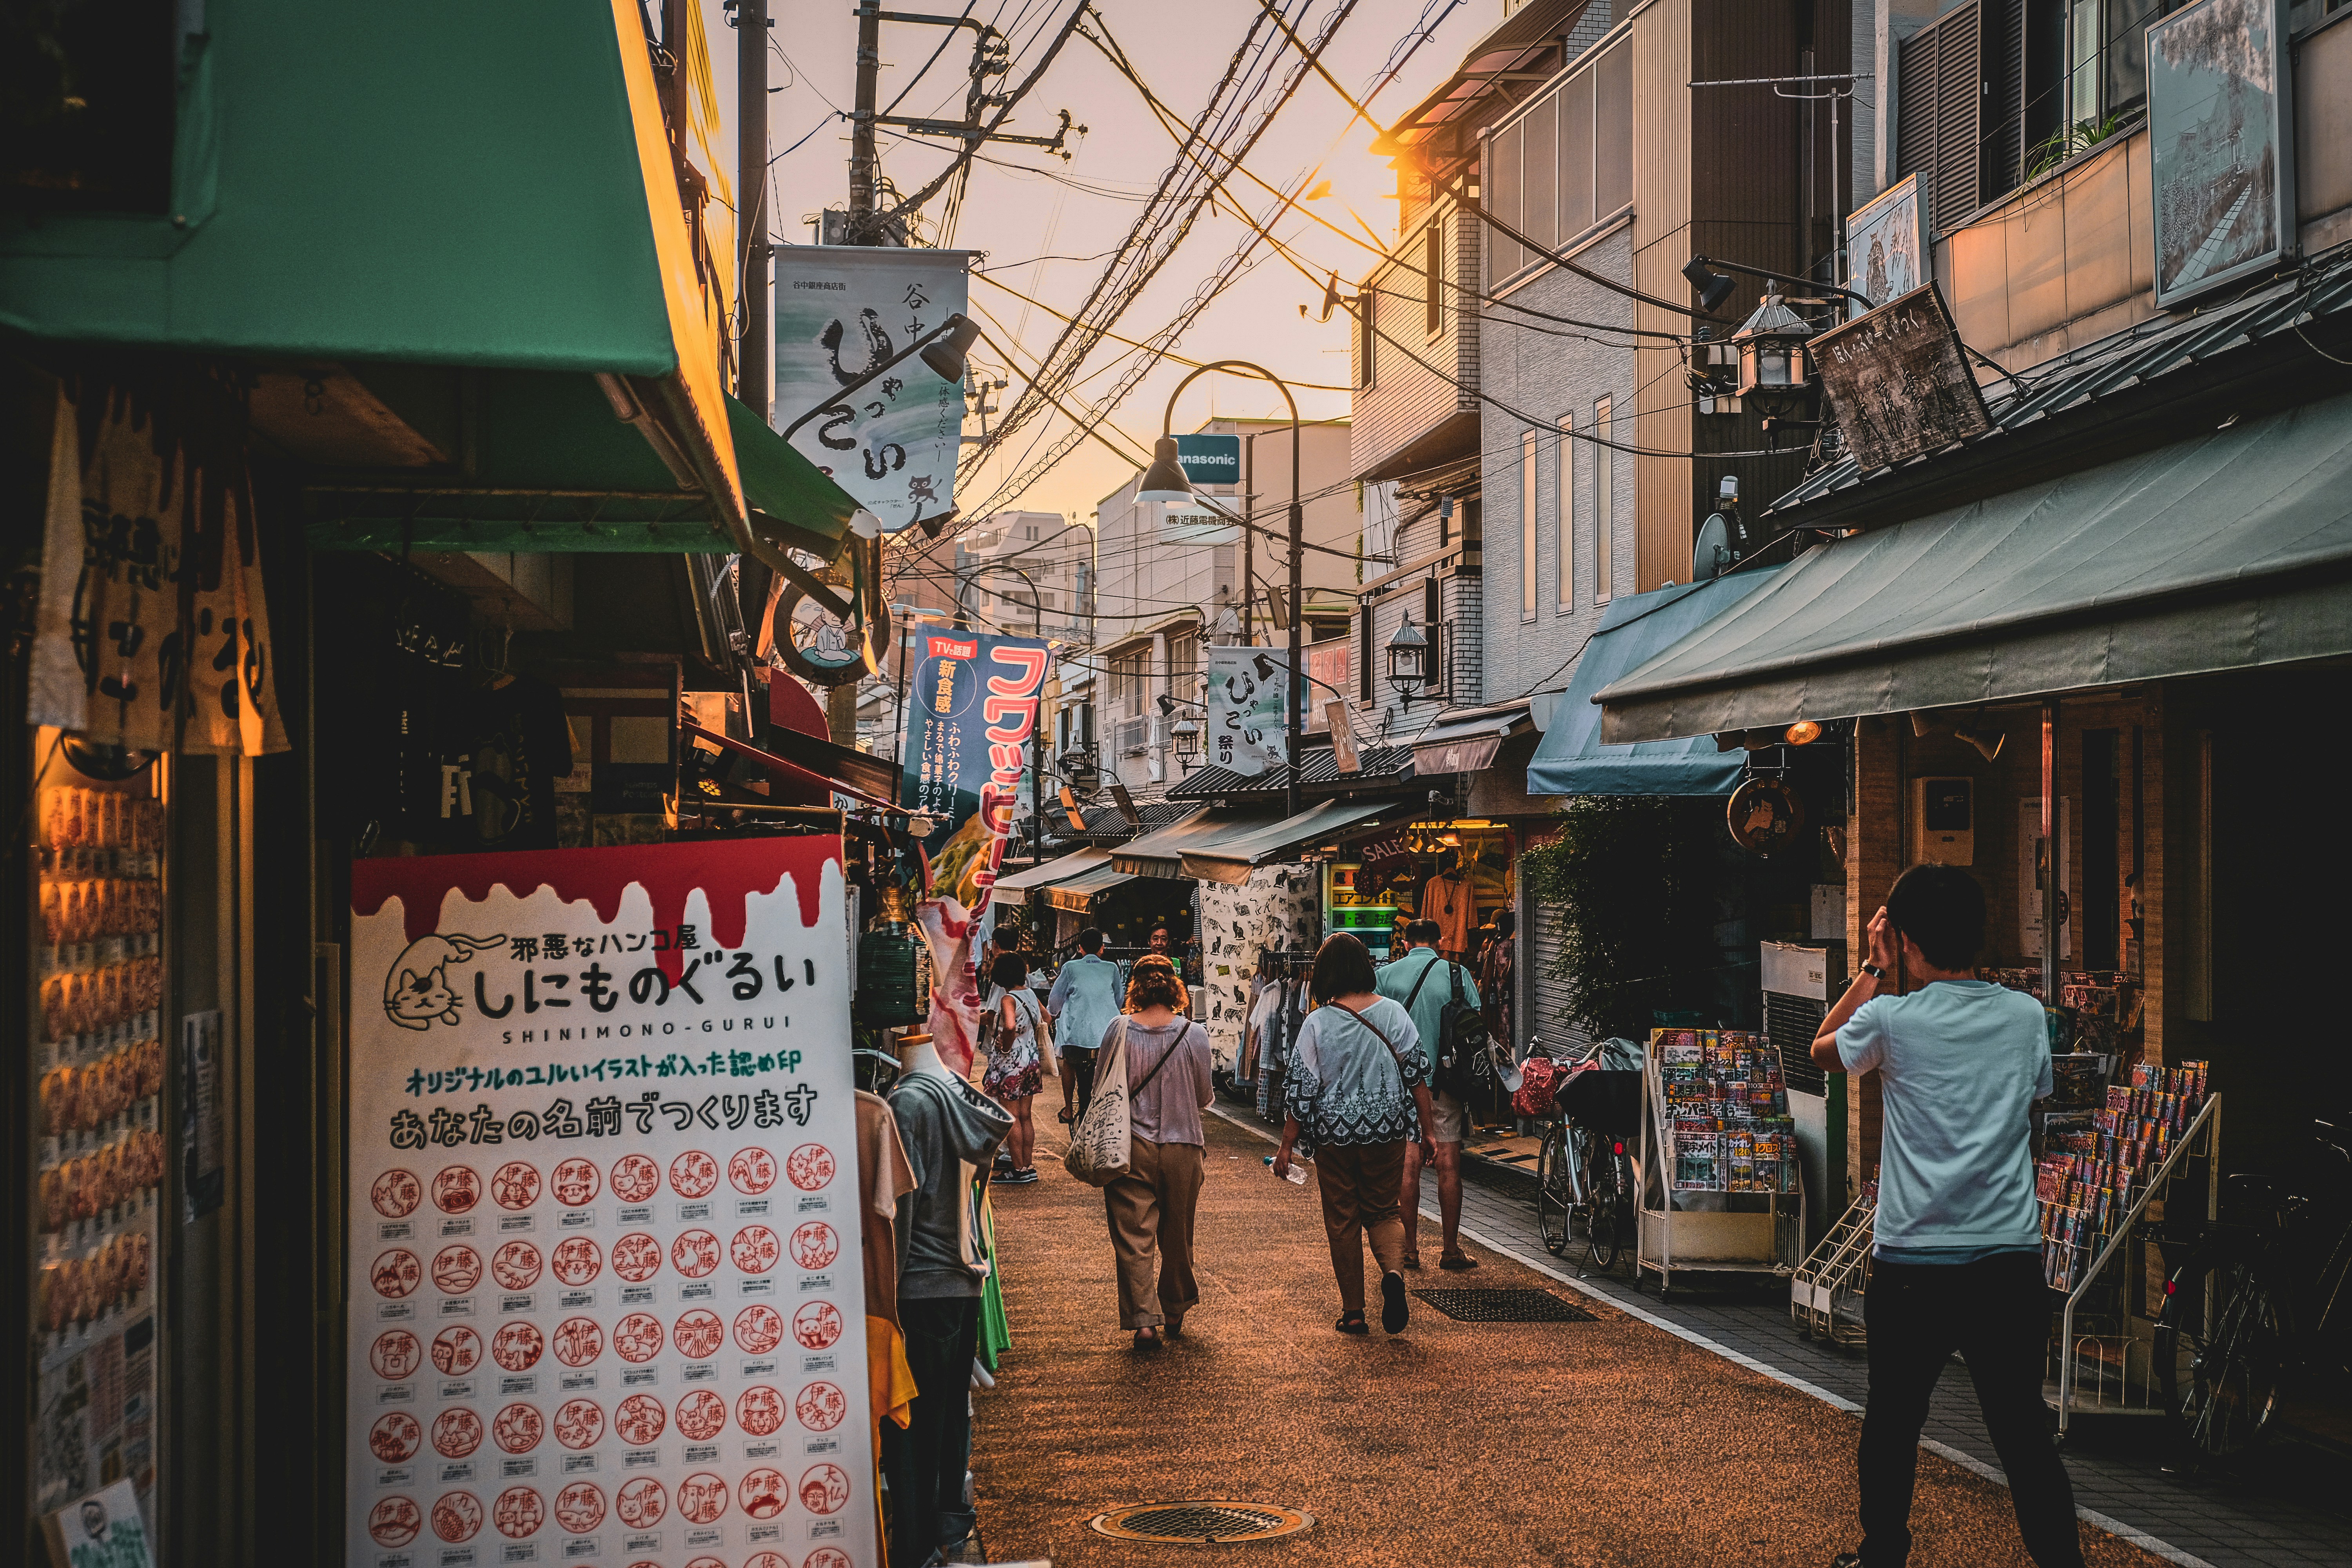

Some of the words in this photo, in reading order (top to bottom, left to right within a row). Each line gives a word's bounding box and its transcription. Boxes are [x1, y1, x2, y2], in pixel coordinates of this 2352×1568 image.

[793, 281, 846, 290] 谷中銀座商店街
[902, 283, 930, 343] 谷中
[1178, 454, 1235, 465] anasonic
[935, 641, 971, 657] TVで話題
[935, 659, 957, 713] 新食感
[1218, 735, 1234, 764] 祭り
[947, 722, 961, 830] ふわふわクリーミー
[834, 796, 849, 810] か
[1363, 839, 1405, 862] SALE
[510, 925, 701, 962] 邪悪なハンコ屋
[474, 952, 817, 1018] しにものぐるい
[503, 1015, 791, 1044] SHINIMONO-GURUI
[405, 1049, 802, 1097] オリジナルのユルいイラストが入った認め印
[390, 1083, 818, 1150] あなたの名前でつくります
[809, 1147, 832, 1178] 伊藤
[1734, 1147, 1751, 1157] 120
[504, 1166, 538, 1188] 伊藤
[558, 1165, 593, 1182] 伊藤
[623, 1158, 655, 1182] 伊藤
[686, 1154, 715, 1178] 伊藤
[748, 1151, 771, 1179] 伊藤
[389, 1172, 417, 1201] 伊藤
[438, 1171, 474, 1188] 伊藤
[751, 1229, 777, 1259] 伊藤
[796, 1225, 830, 1244] 伊藤
[436, 1250, 474, 1271] 伊藤
[503, 1246, 537, 1267] 伊藤
[559, 1241, 594, 1261] 伊藤
[635, 1237, 659, 1269] 伊藤
[695, 1236, 715, 1269] 伊藤
[392, 1253, 418, 1281] 伊藤
[626, 1317, 660, 1341] 伊藤
[749, 1308, 780, 1335] 伊藤
[818, 1305, 838, 1338] 伊藤
[378, 1335, 414, 1355] 伊藤
[454, 1331, 473, 1367] 伊藤
[497, 1328, 534, 1347] 伊藤
[581, 1324, 599, 1358] 伊藤
[677, 1328, 722, 1346] 伊藤
[697, 1393, 724, 1422] 伊藤
[744, 1390, 777, 1409] 伊藤
[809, 1385, 842, 1410] 伊藤
[439, 1413, 474, 1432] 伊藤
[508, 1406, 540, 1432] 伊藤
[563, 1405, 600, 1426] 伊藤
[387, 1416, 418, 1441] 伊藤
[619, 1418, 650, 1442] 伊藤
[744, 1474, 782, 1494] 伊藤
[824, 1466, 845, 1502] 大仏
[501, 1491, 537, 1511] 伊藤
[561, 1488, 597, 1507] 伊藤
[642, 1483, 661, 1519] 伊藤
[701, 1481, 725, 1519] 伊藤
[377, 1503, 414, 1522] 伊藤
[456, 1494, 480, 1532] カフカ
